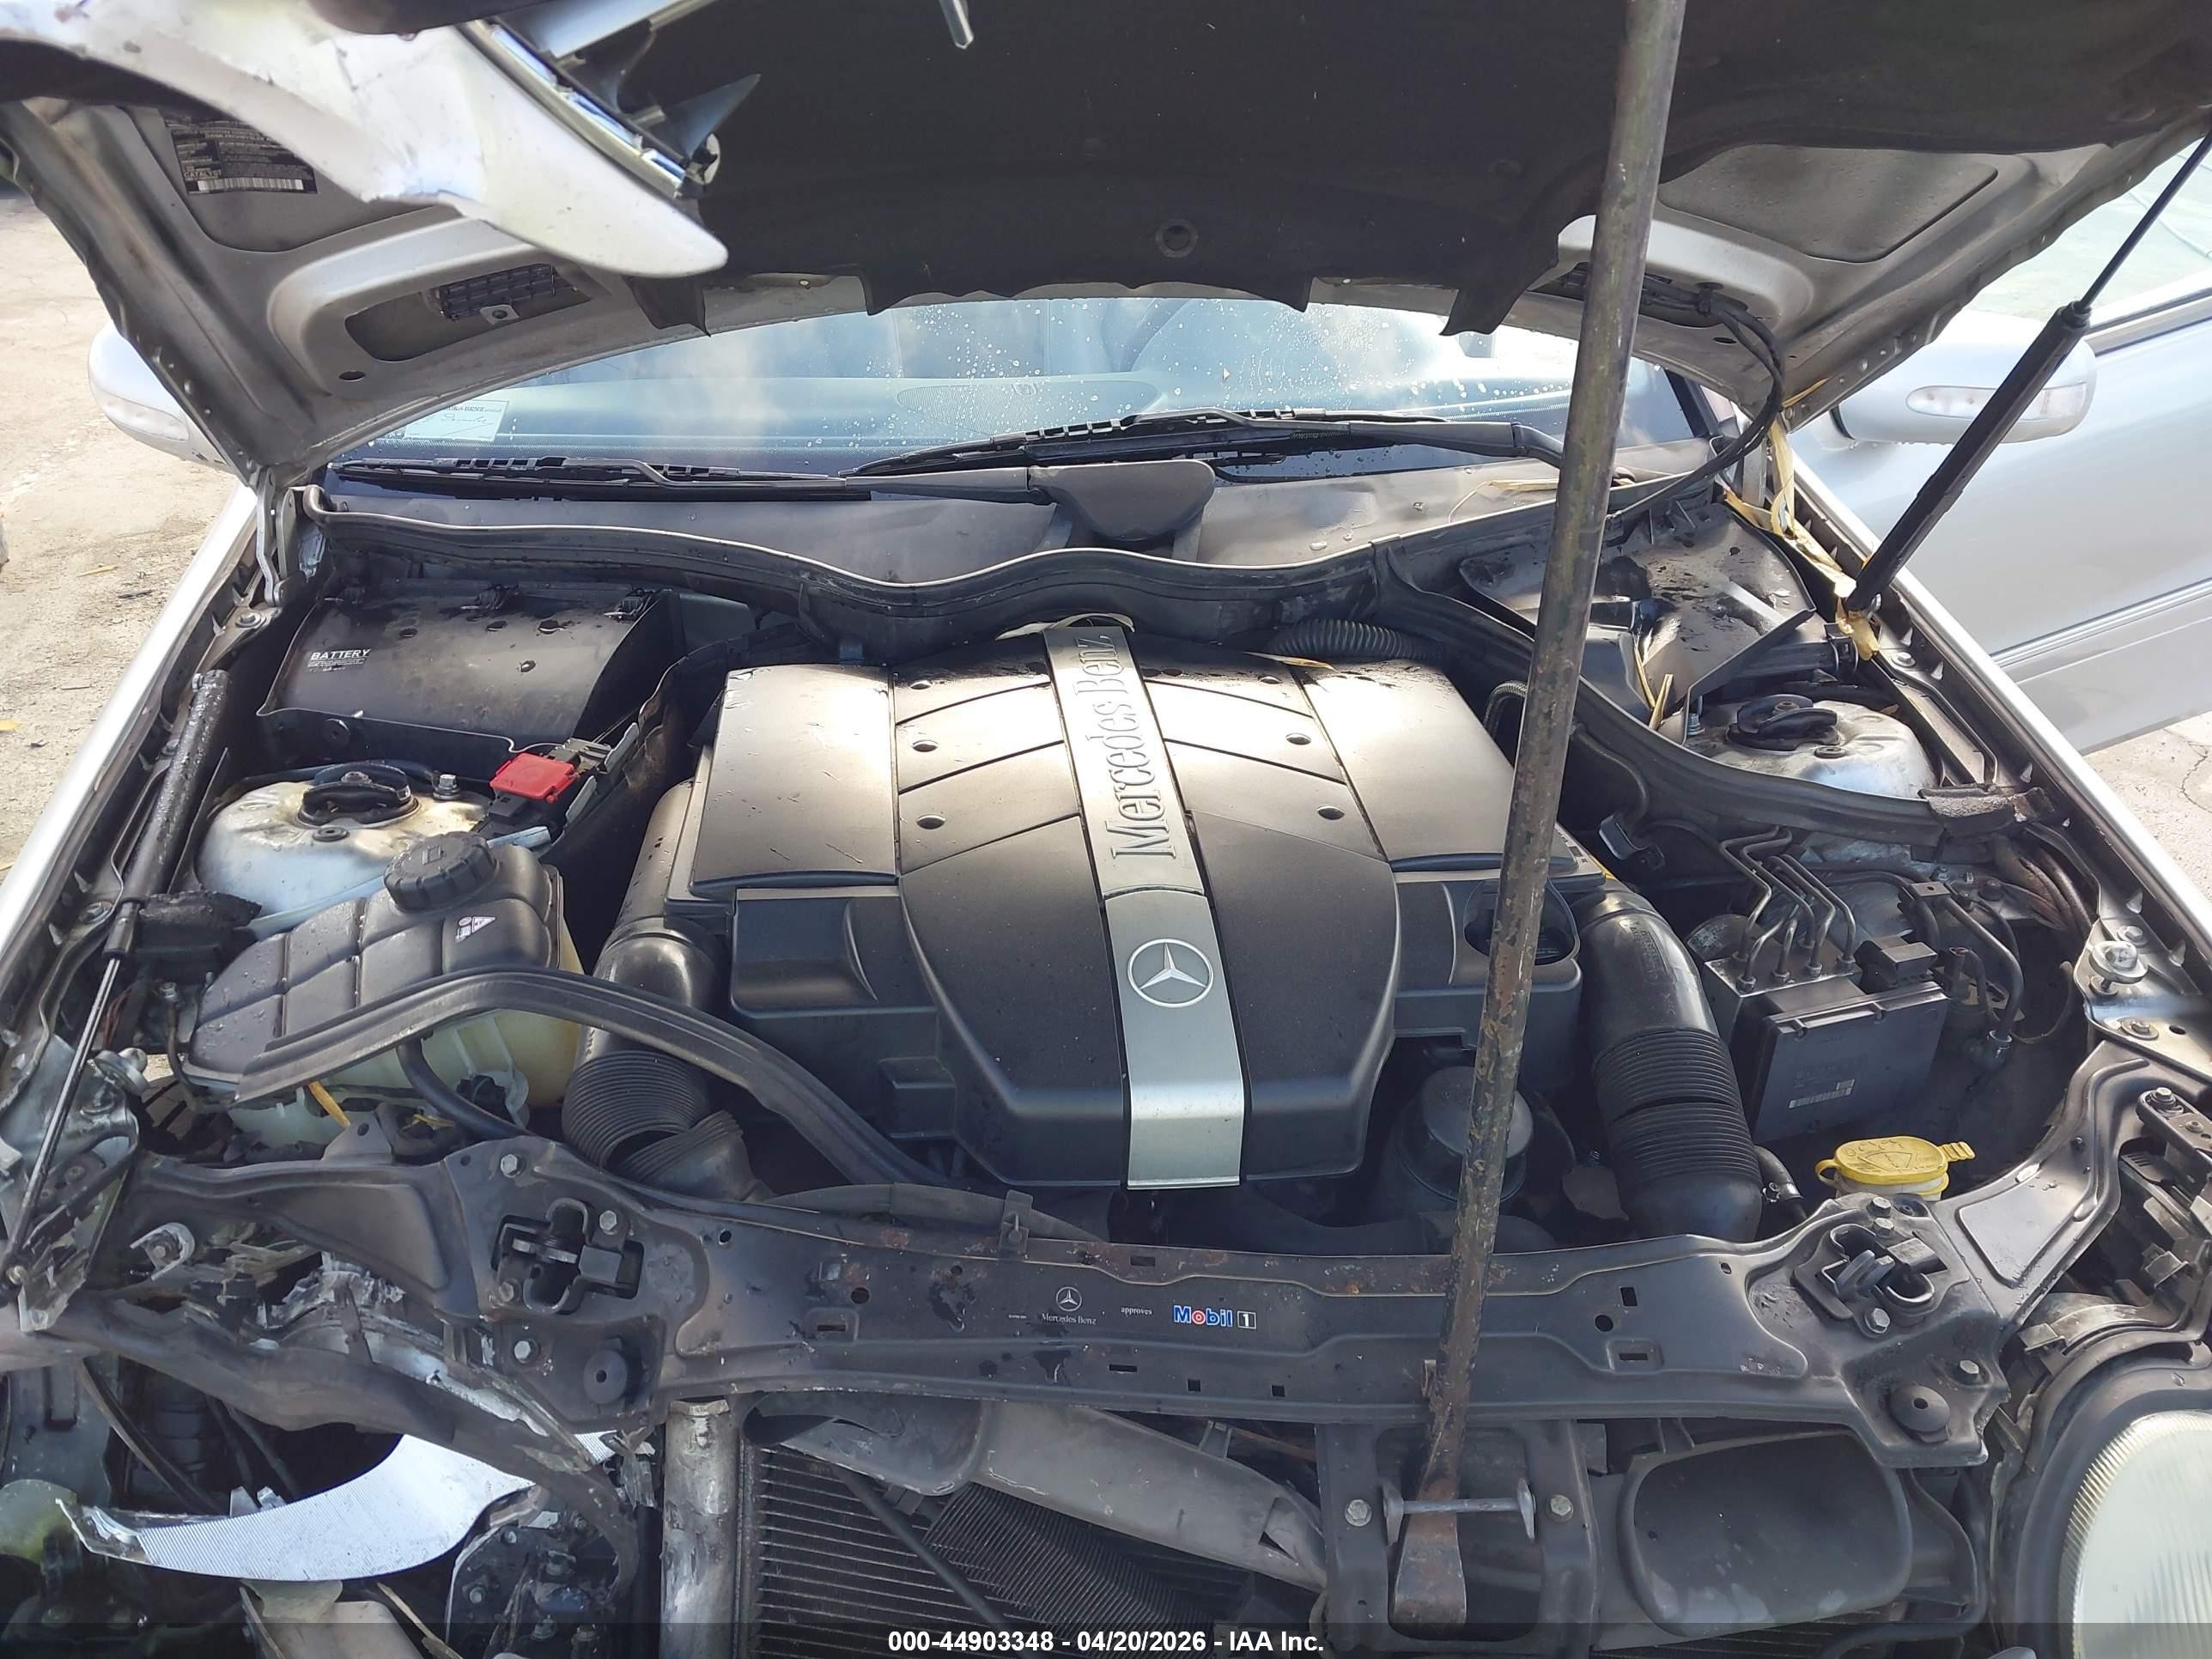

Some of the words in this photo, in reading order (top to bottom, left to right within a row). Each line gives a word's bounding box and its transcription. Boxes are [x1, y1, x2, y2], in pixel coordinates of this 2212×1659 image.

[310, 648, 372, 660] BATTERY
[1073, 635, 1129, 696] Benz
[1085, 702, 1176, 859] Mercedes
[1077, 1316, 1097, 1325] Benz
[1121, 1306, 1152, 1316] approves
[1173, 1304, 1233, 1328] Mobil
